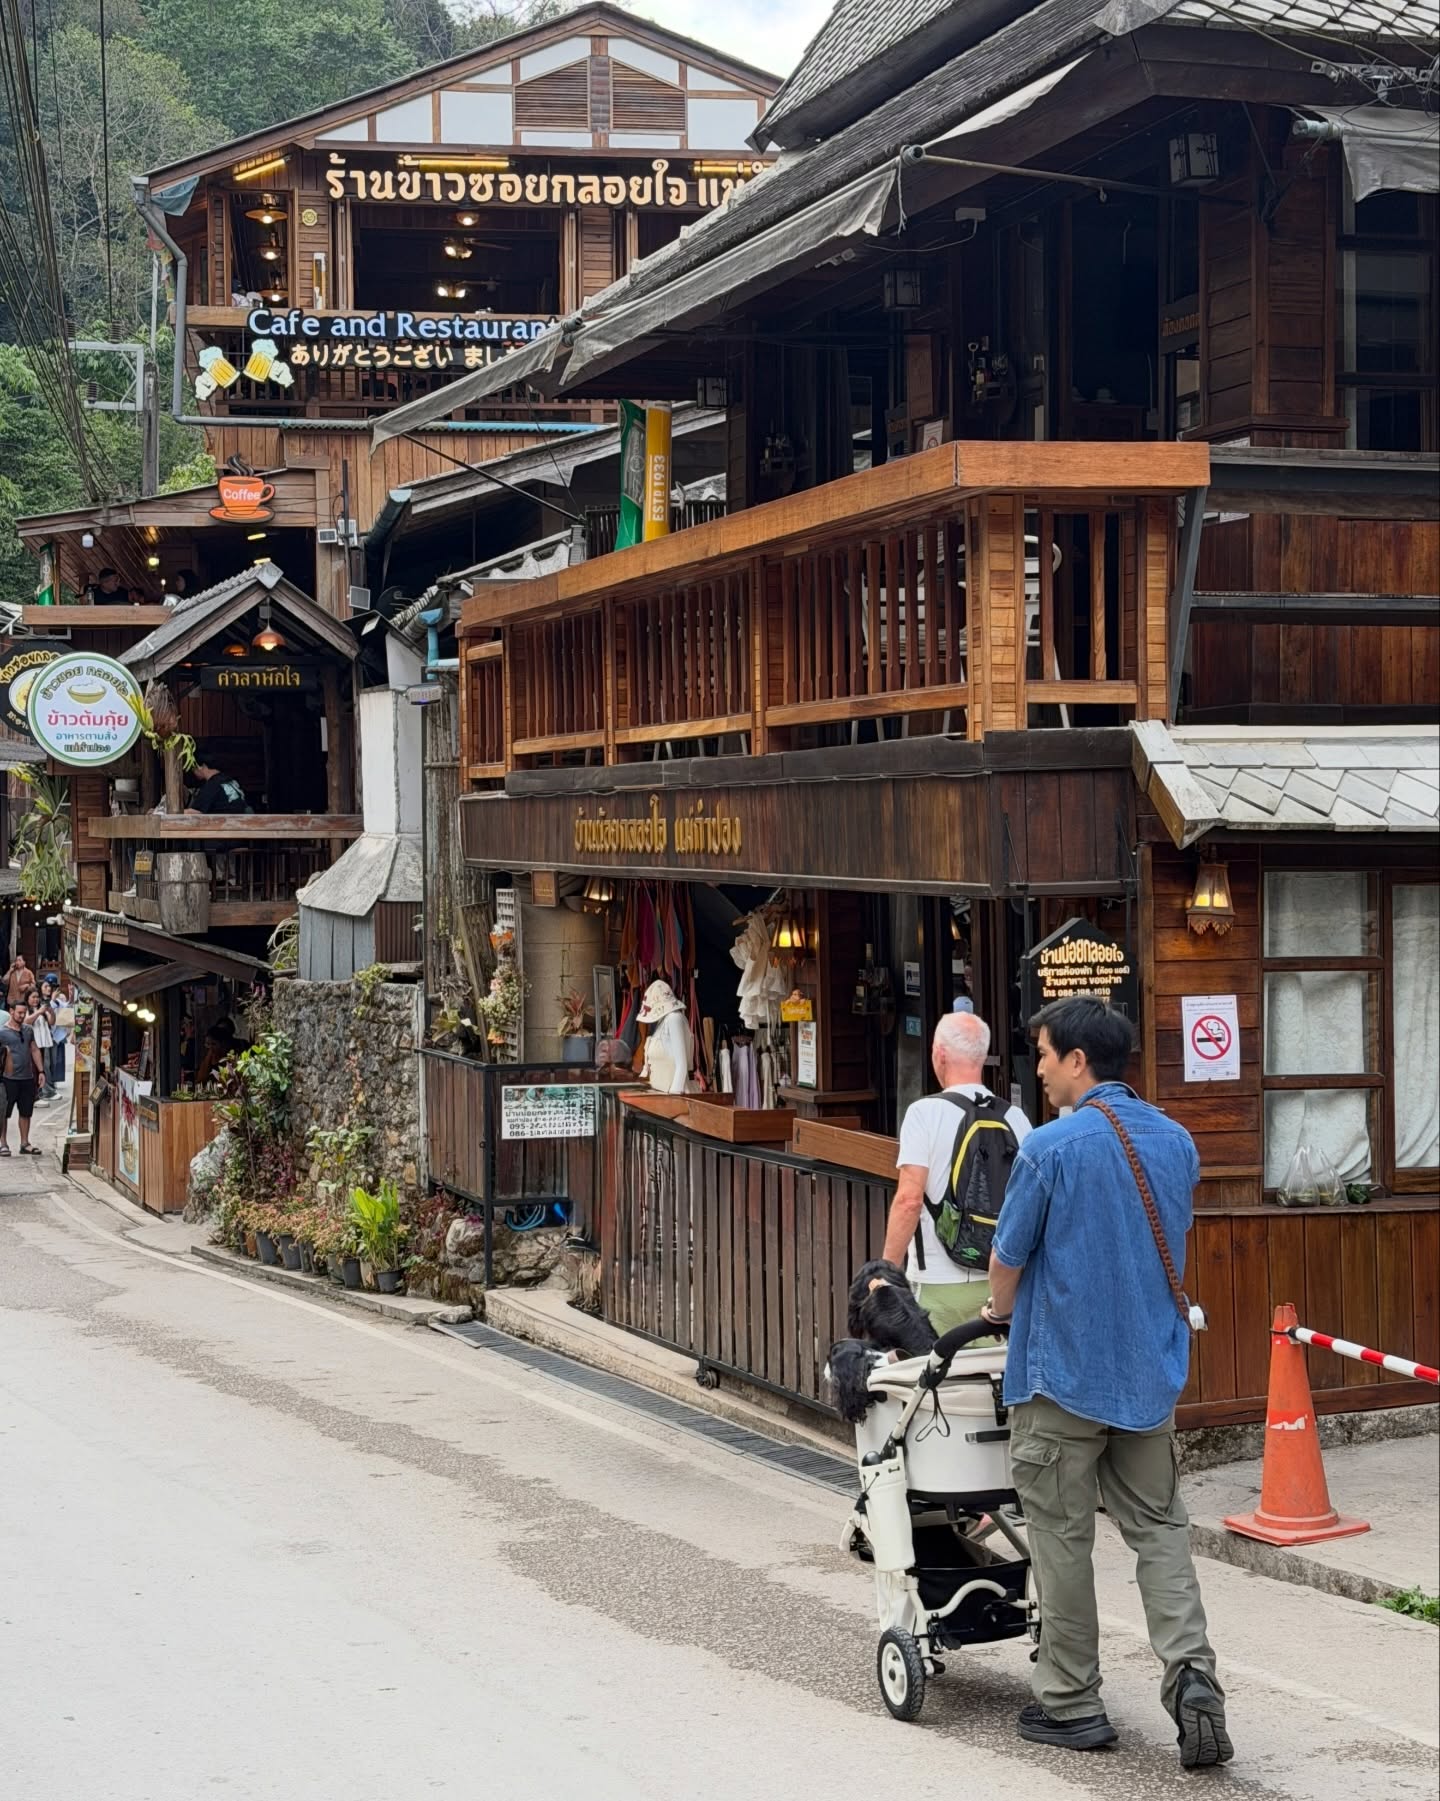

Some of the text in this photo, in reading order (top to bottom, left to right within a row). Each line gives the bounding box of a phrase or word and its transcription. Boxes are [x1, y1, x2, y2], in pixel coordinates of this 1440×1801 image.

[326, 152, 687, 206] ร้านข้าวซอยกลอยใจ
[249, 310, 320, 336] Cafe
[331, 312, 386, 337] and
[290, 343, 454, 368] ありがとうござい
[653, 455, 665, 487] 1933
[223, 488, 261, 500] Coffee
[218, 664, 300, 687] ศาลาพักใจ
[48, 709, 129, 731] ข้าวต้มกุ้ย
[56, 729, 118, 741] อาหารตามสั่ง
